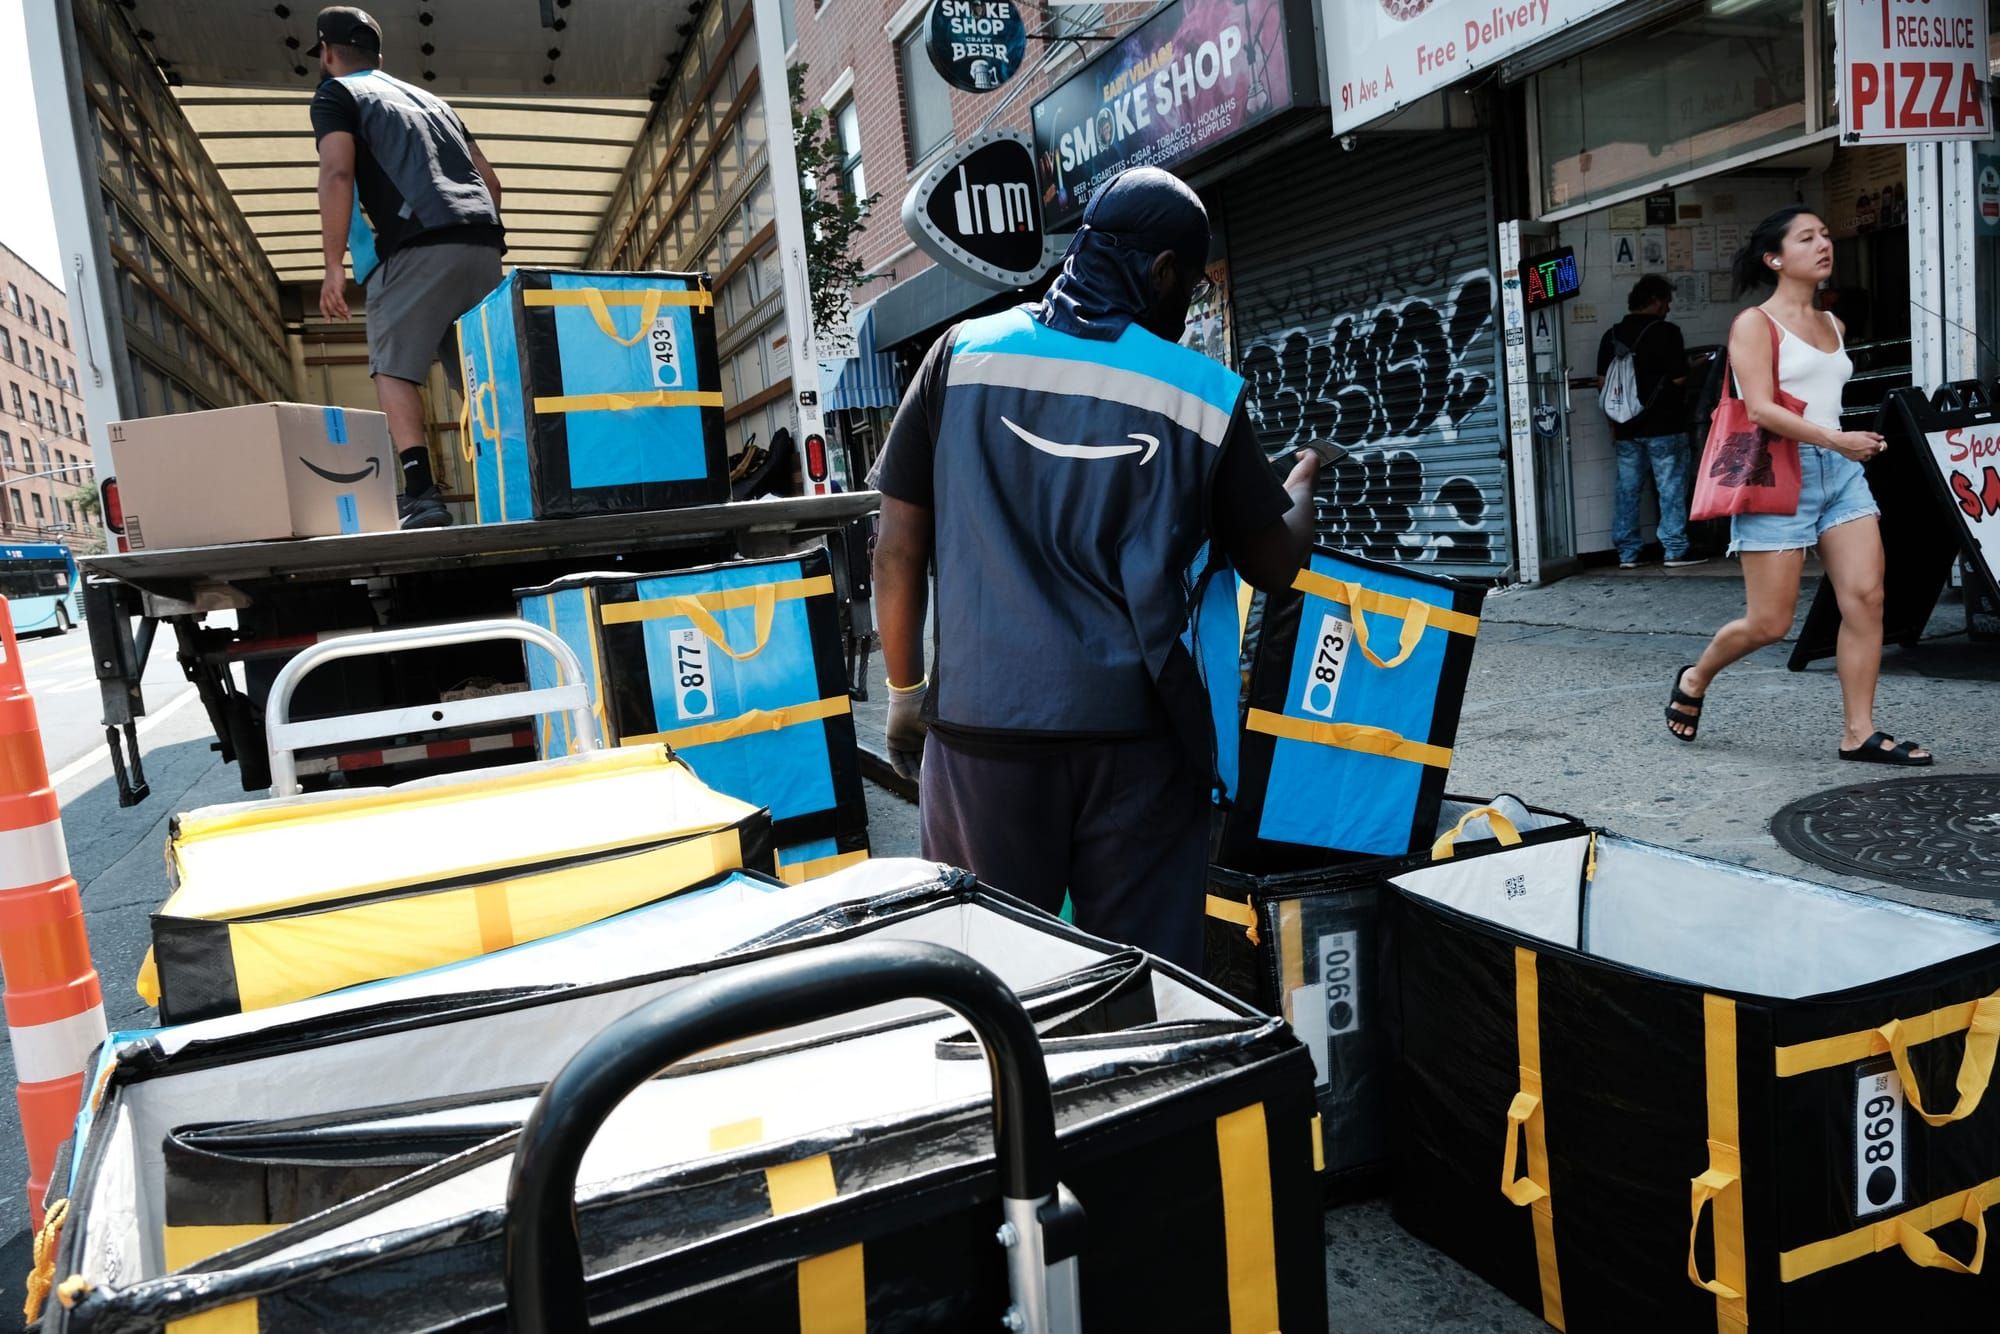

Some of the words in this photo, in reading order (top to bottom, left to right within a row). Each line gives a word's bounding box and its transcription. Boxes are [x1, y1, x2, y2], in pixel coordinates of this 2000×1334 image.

[951, 18, 1005, 35] SHOP
[1416, 41, 1456, 76] Free
[1464, 0, 1550, 53] Delivery
[1896, 16, 1975, 49] REG.SLICE
[951, 42, 1009, 63] BEER
[1103, 72, 1128, 102] EAST
[1129, 41, 1173, 86] VILLAGE
[1060, 82, 1151, 172] SMOKE
[1153, 25, 1242, 116] SHOP
[1341, 82, 1354, 112] 91
[1359, 77, 1378, 104] Ave
[1384, 64, 1394, 92] A
[1852, 62, 1984, 130] PIZZA
[1073, 181, 1087, 197] BEER
[1091, 159, 1126, 186] CIGARETTES
[1130, 145, 1151, 165] CIGAR
[1156, 122, 1192, 150] TOBACCO
[1197, 97, 1237, 127] HOOKAHS
[1144, 137, 1190, 168] ACCESSORIES
[1190, 133, 1197, 144] &
[1197, 113, 1232, 141] SUPPLIES
[953, 164, 1034, 236] drom
[1617, 237, 1633, 263] A
[1527, 255, 1579, 304] ATM
[652, 329, 674, 363] 493
[1536, 310, 1549, 337] A
[677, 645, 705, 688] 877
[1315, 634, 1344, 683] 873
[1326, 949, 1351, 1000] 900
[1864, 1095, 1895, 1164] 869
